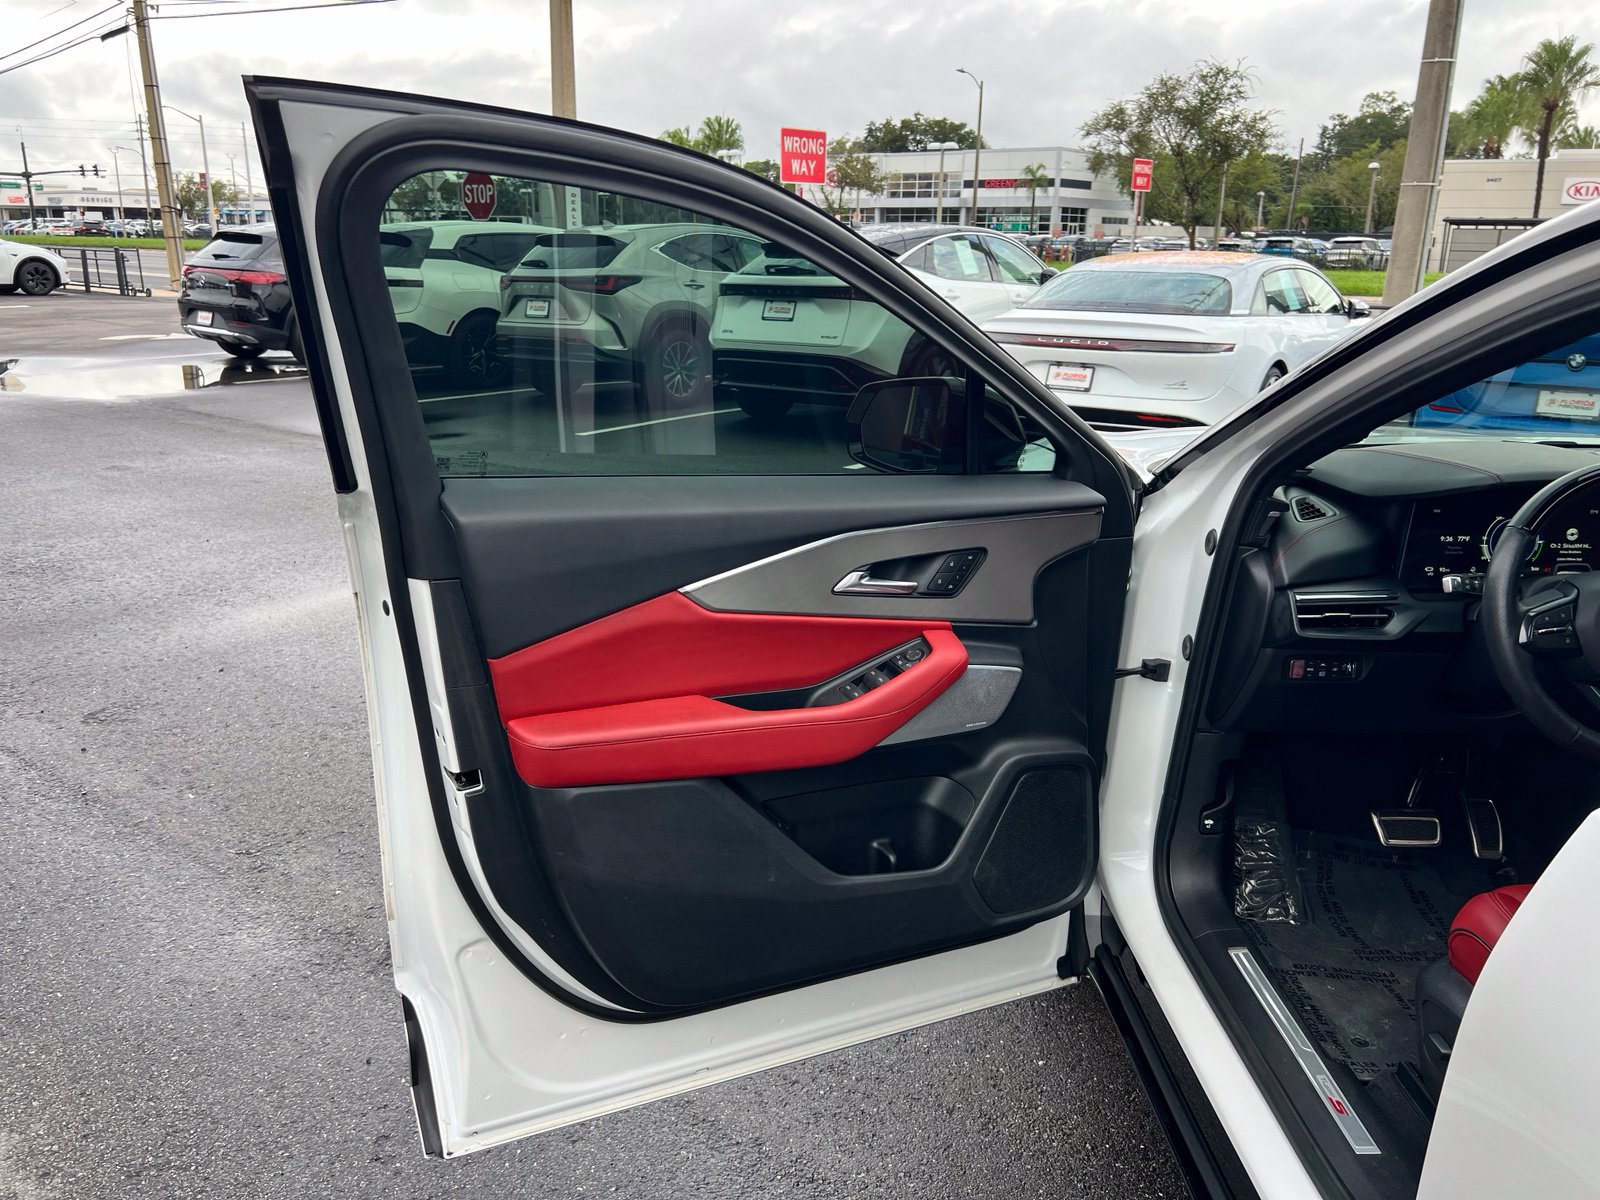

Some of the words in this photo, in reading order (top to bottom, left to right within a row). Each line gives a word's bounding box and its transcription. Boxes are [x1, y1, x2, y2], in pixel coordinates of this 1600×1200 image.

[784, 136, 824, 155] WRONG
[791, 159, 816, 176] WAY
[464, 184, 493, 203] STOP
